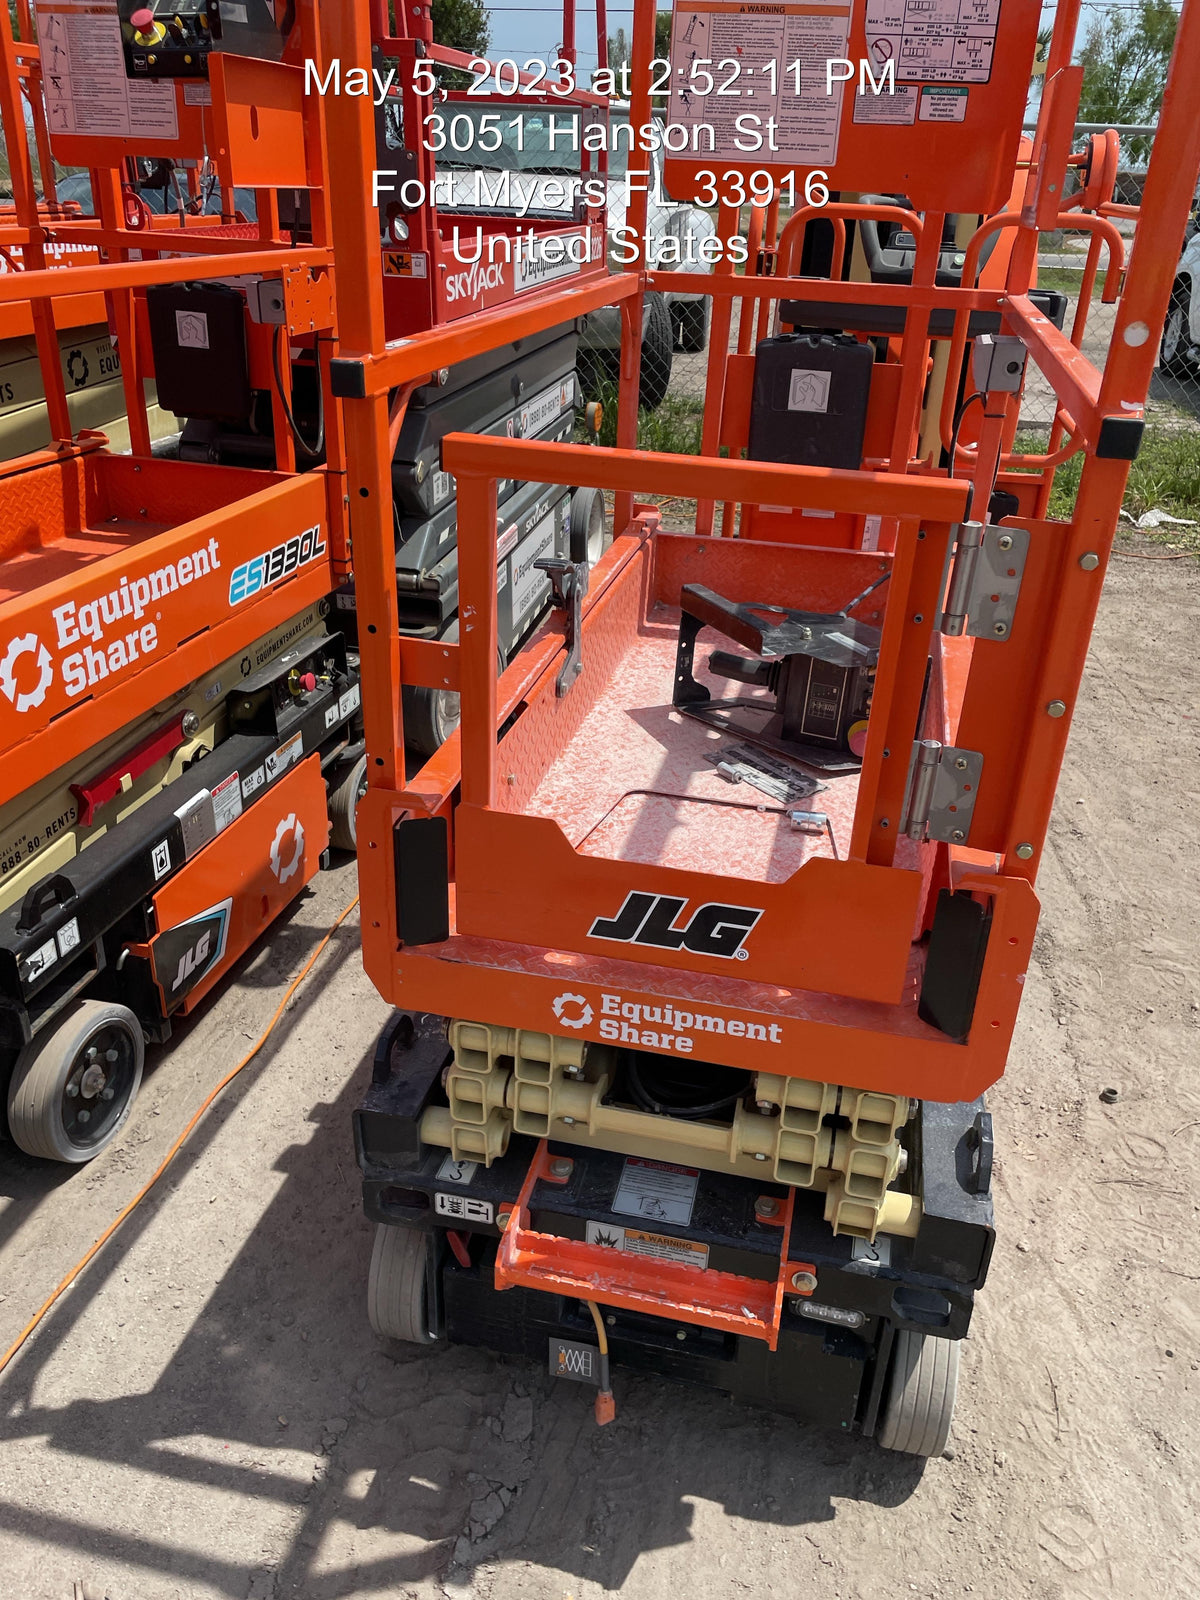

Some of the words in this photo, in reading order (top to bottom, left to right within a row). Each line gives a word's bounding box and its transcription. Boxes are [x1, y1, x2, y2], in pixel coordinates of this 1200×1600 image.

[747, 5, 786, 14] WARNING
[445, 262, 505, 302] SKYJACK
[229, 523, 327, 607] ES1330L
[51, 536, 221, 650] Equipment
[60, 621, 158, 698] Share
[256, 613, 314, 666] EQUIPMENTSHARE.COM
[585, 889, 766, 960] JLG
[172, 929, 211, 992] JLG
[599, 1018, 694, 1053] Share
[600, 993, 783, 1044] Equipment
[648, 1235, 693, 1251] WARNING
